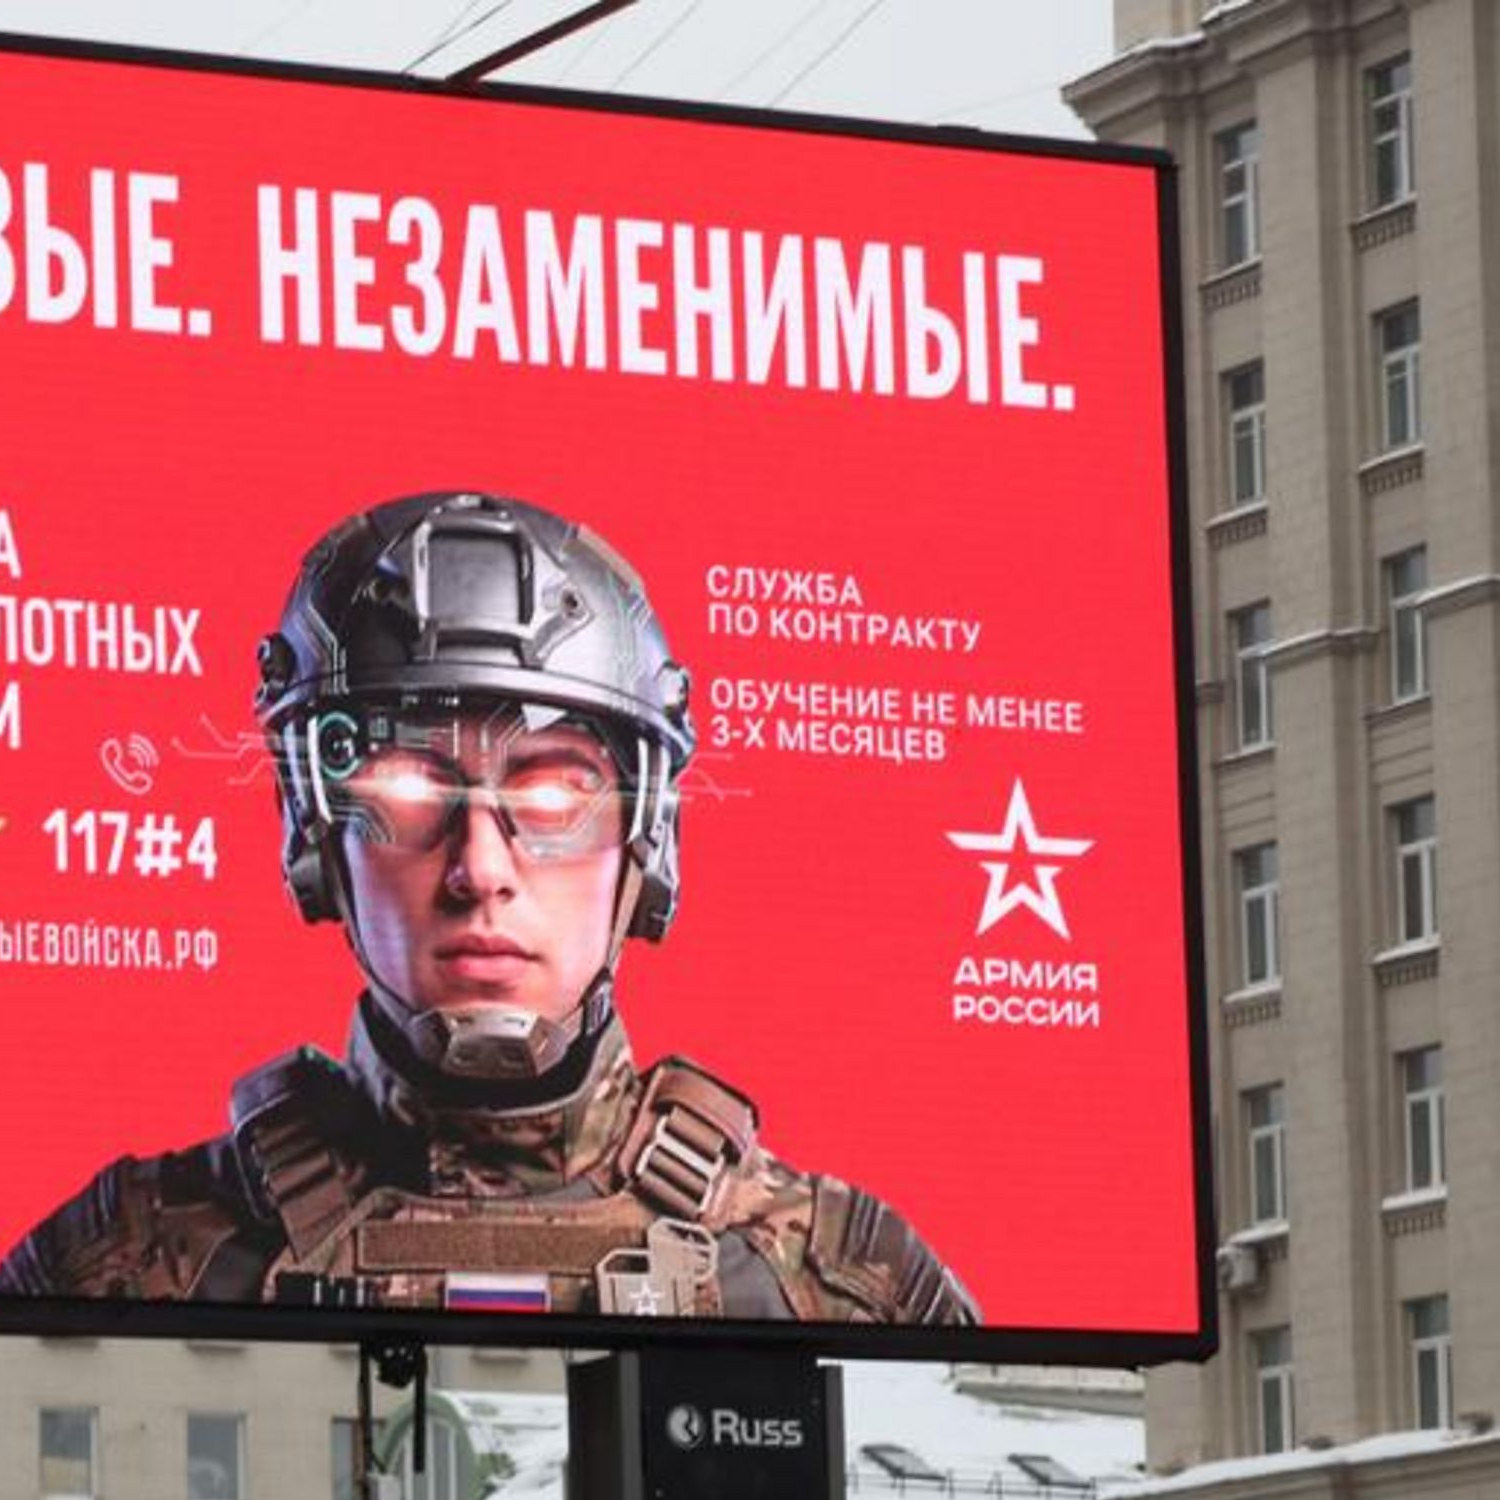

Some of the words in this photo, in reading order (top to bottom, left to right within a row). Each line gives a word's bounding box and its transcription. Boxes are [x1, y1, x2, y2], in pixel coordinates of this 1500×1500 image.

[256, 183, 1077, 413] НЕЗАМЕНИМЫЕ.
[705, 564, 863, 607] СЛУЖБА
[707, 601, 760, 637] ПО
[768, 607, 982, 654] КОНТРАКТУ
[709, 677, 901, 722] ОБУЧЕНИЕ
[911, 690, 957, 725] НЕ
[965, 694, 1084, 735] МЕНЕЕ
[710, 713, 766, 749] 3-Х
[776, 718, 946, 764] МЕСЯЦЕВ
[42, 807, 219, 881] 117#4
[952, 955, 1099, 993] АРМИЯ
[952, 993, 1101, 1028] РОССИИ
[711, 1408, 804, 1448] Russ
